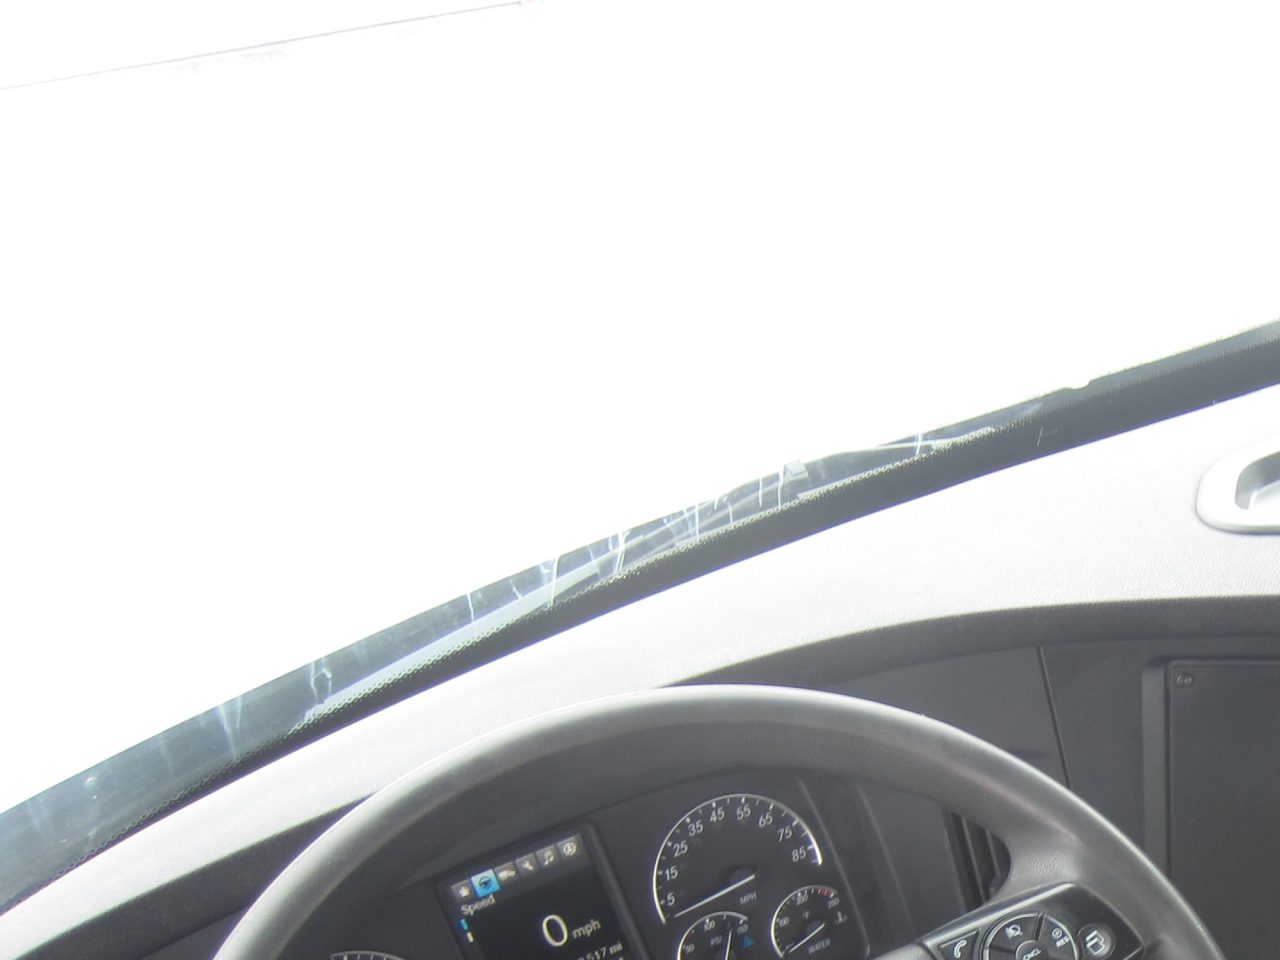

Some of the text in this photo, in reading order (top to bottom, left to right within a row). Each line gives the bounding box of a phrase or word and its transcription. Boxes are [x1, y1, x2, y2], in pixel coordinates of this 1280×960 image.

[710, 807, 725, 823] 45
[736, 804, 751, 821] 55
[758, 813, 773, 828] 65
[688, 820, 703, 836] 35
[777, 826, 792, 843] 75
[673, 840, 688, 857] 25
[791, 847, 806, 862] 85
[664, 865, 678, 881] 15
[460, 894, 495, 916] Speed
[667, 893, 676, 906] 5
[541, 913, 601, 947] 0 mph
